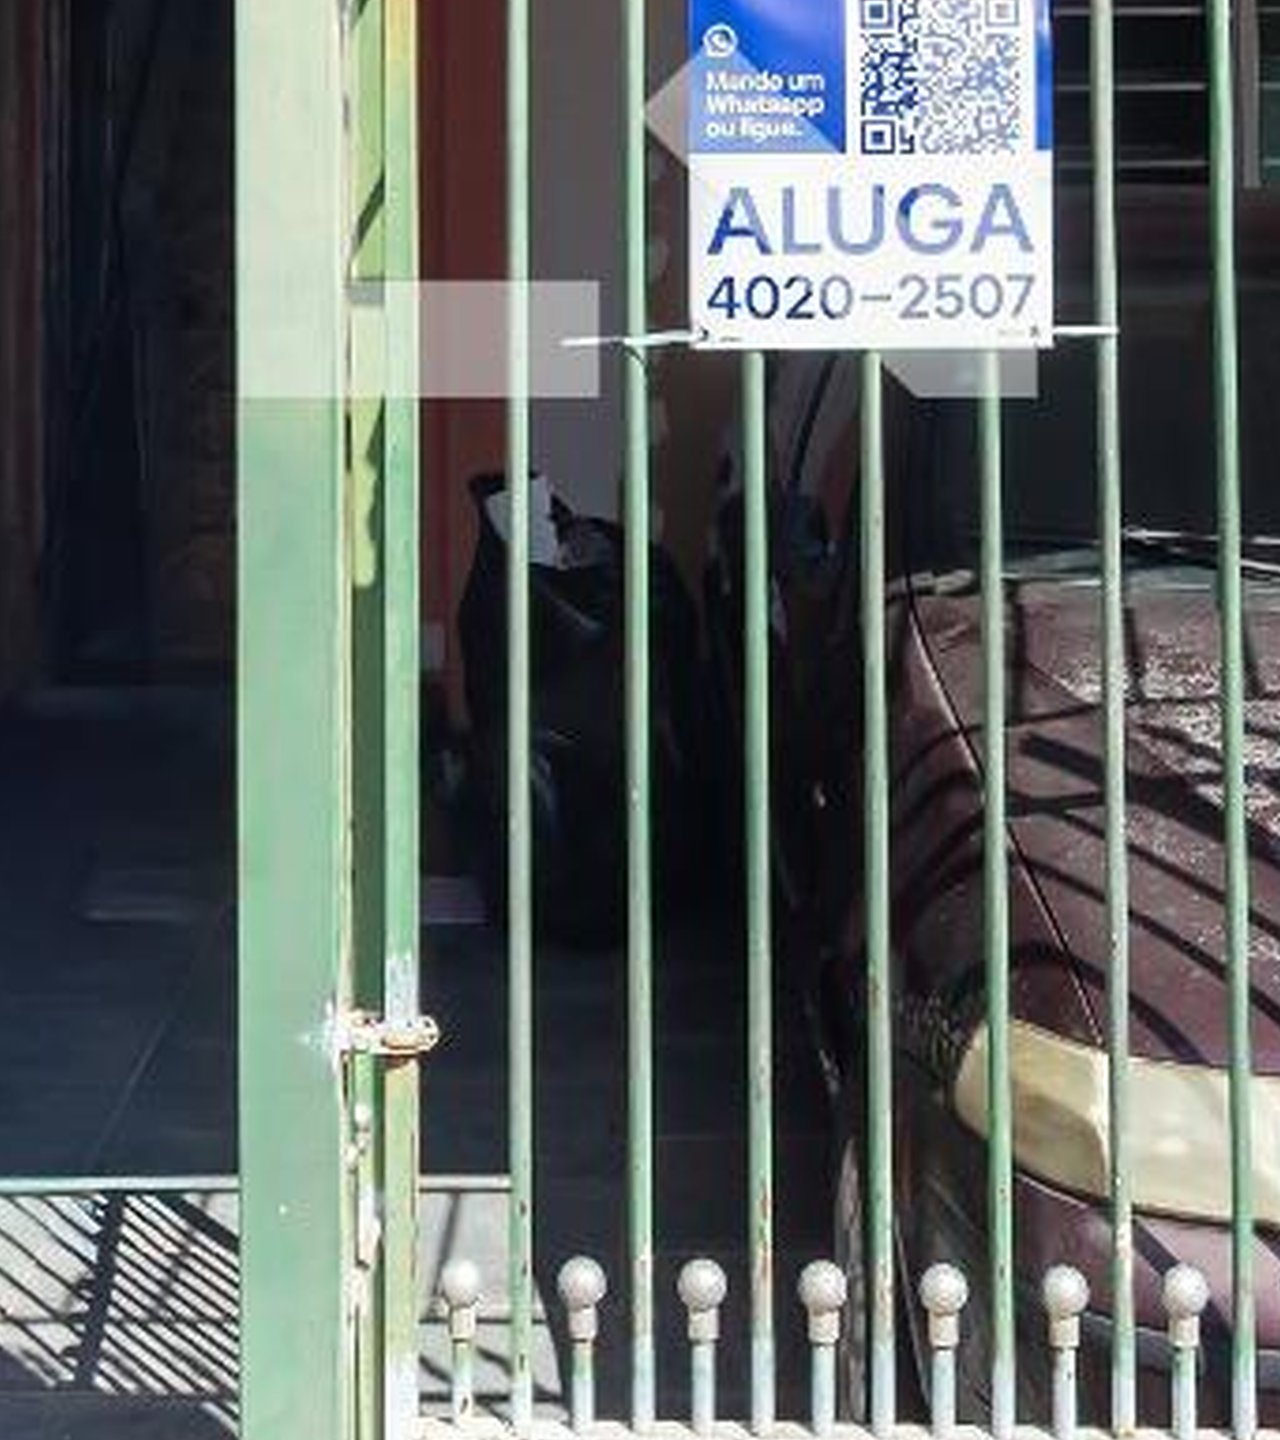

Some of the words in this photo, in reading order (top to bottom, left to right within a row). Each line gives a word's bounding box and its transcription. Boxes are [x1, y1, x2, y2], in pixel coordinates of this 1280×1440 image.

[788, 73, 825, 91] um
[706, 121, 734, 138] ou
[706, 183, 1036, 257] ALUGA
[706, 273, 1037, 320] 4020-2507
